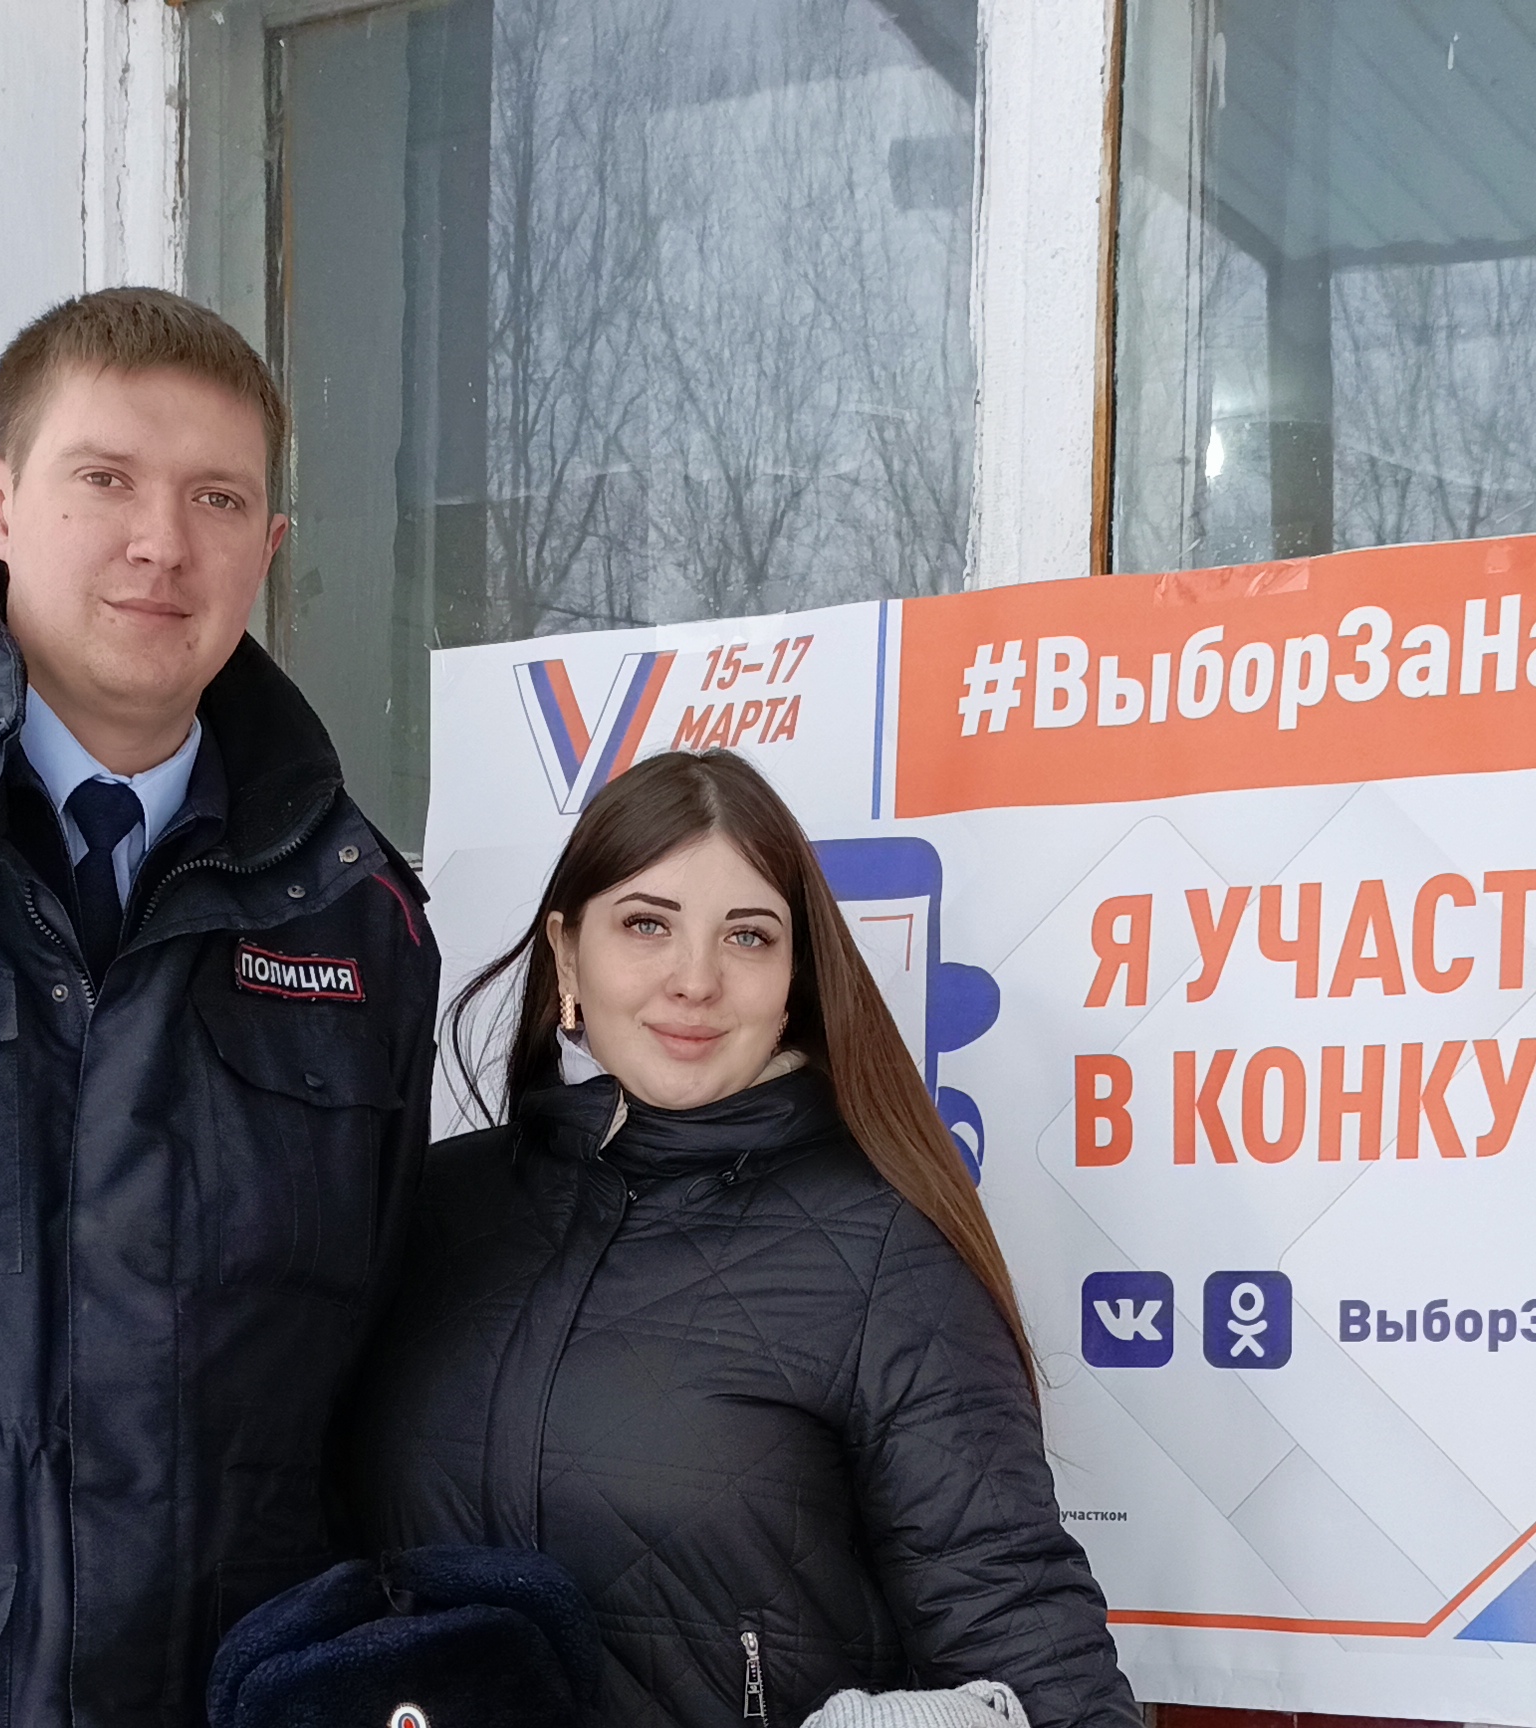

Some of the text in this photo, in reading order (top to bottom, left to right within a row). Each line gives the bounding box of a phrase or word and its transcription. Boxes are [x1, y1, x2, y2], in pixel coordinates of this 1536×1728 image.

[670, 695, 801, 750] МАРТА
[241, 952, 355, 991] ПОЛИЦИЯ
[1083, 893, 1153, 1008] Я
[1074, 1053, 1134, 1167] В
[1061, 1510, 1127, 1523] участком
